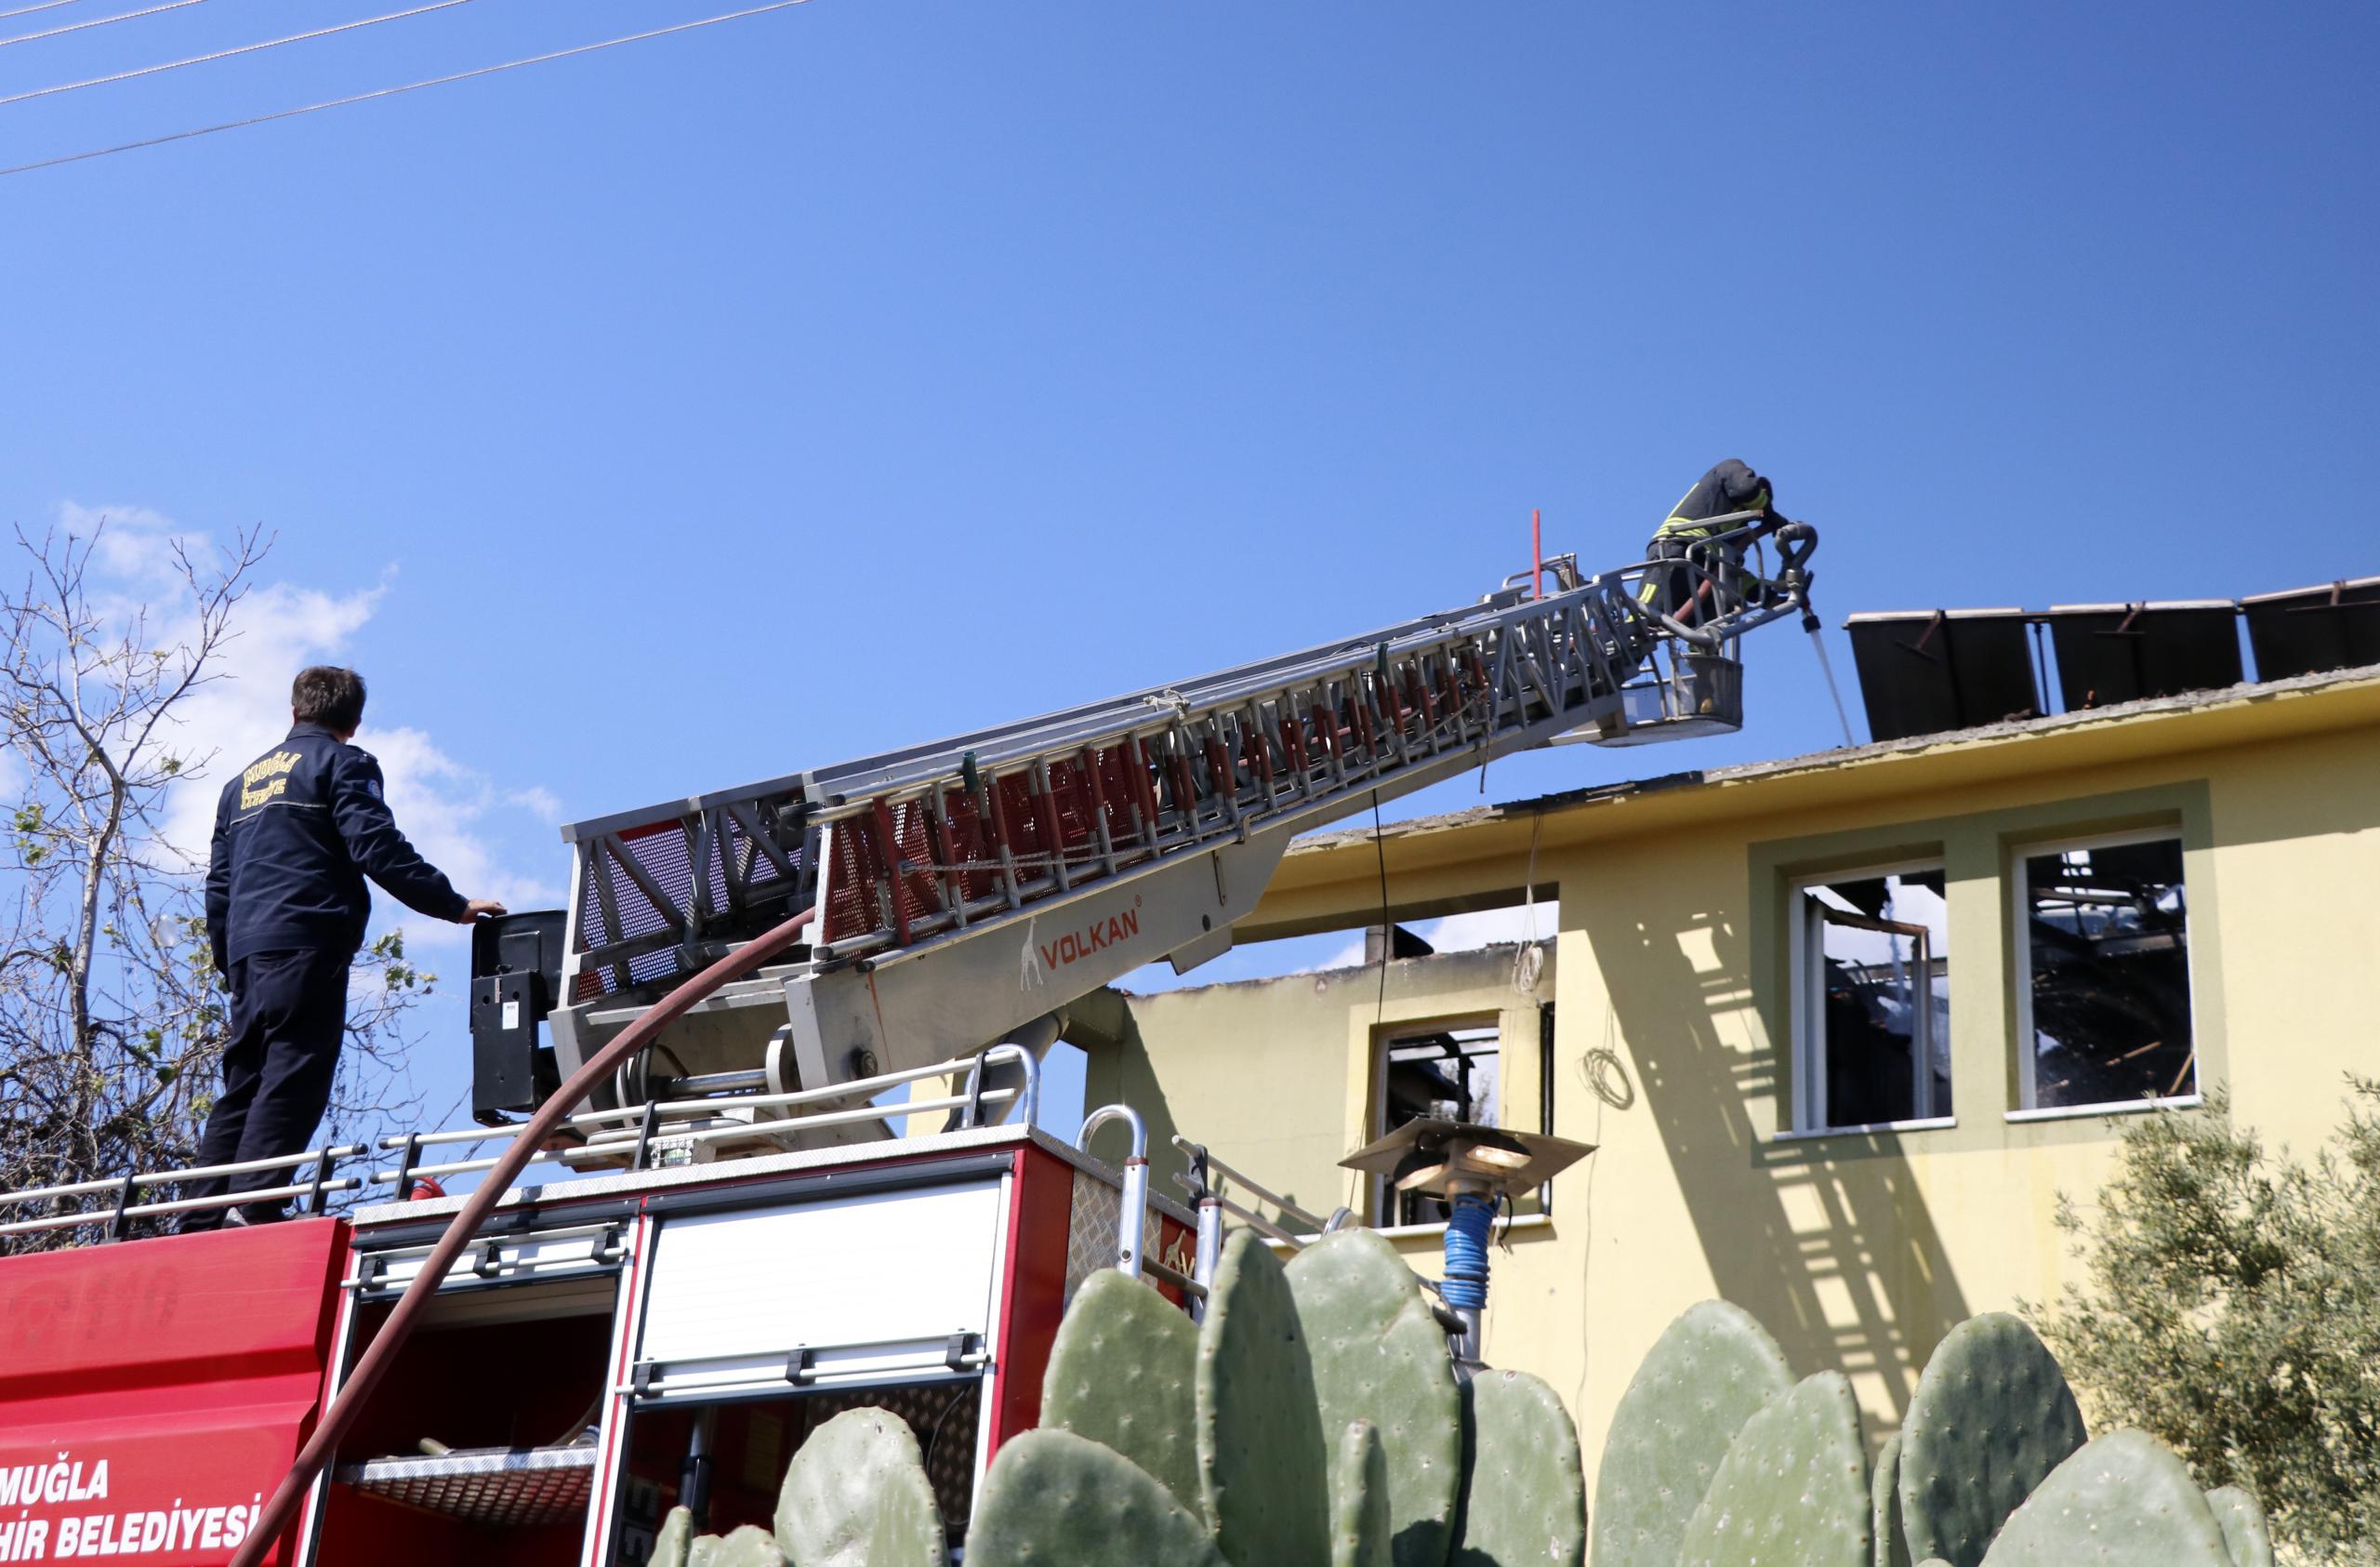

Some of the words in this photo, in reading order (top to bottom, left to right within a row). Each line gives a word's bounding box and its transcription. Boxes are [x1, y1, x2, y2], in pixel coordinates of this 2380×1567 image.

[1040, 909, 1139, 970] VOLKAN
[0, 1451, 108, 1506] MUĞLA
[54, 1493, 261, 1559] BELEDİYESİ
